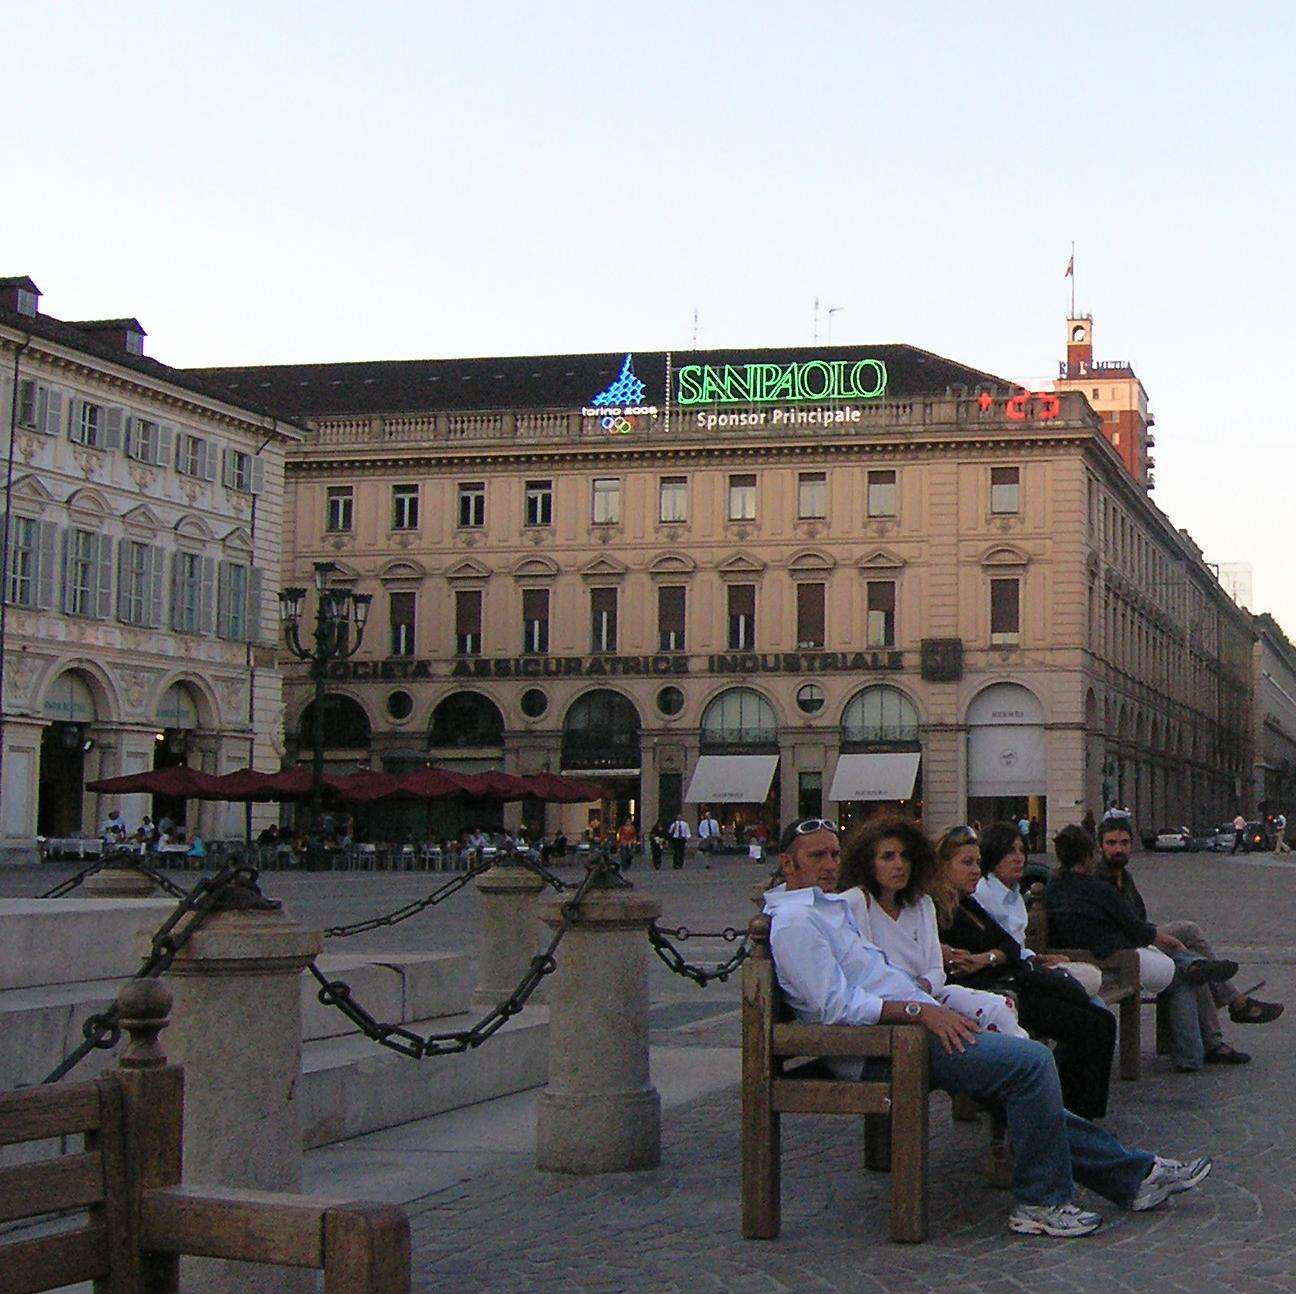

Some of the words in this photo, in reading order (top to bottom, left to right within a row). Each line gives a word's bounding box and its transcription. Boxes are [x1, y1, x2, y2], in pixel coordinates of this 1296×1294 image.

[678, 359, 888, 404] SANPAOLO
[582, 407, 622, 417] torino
[697, 411, 767, 430] Sponsor
[773, 406, 861, 427] Principale
[450, 656, 690, 677] ASSICURATRICE
[708, 651, 904, 674] INDUSTRIALE
